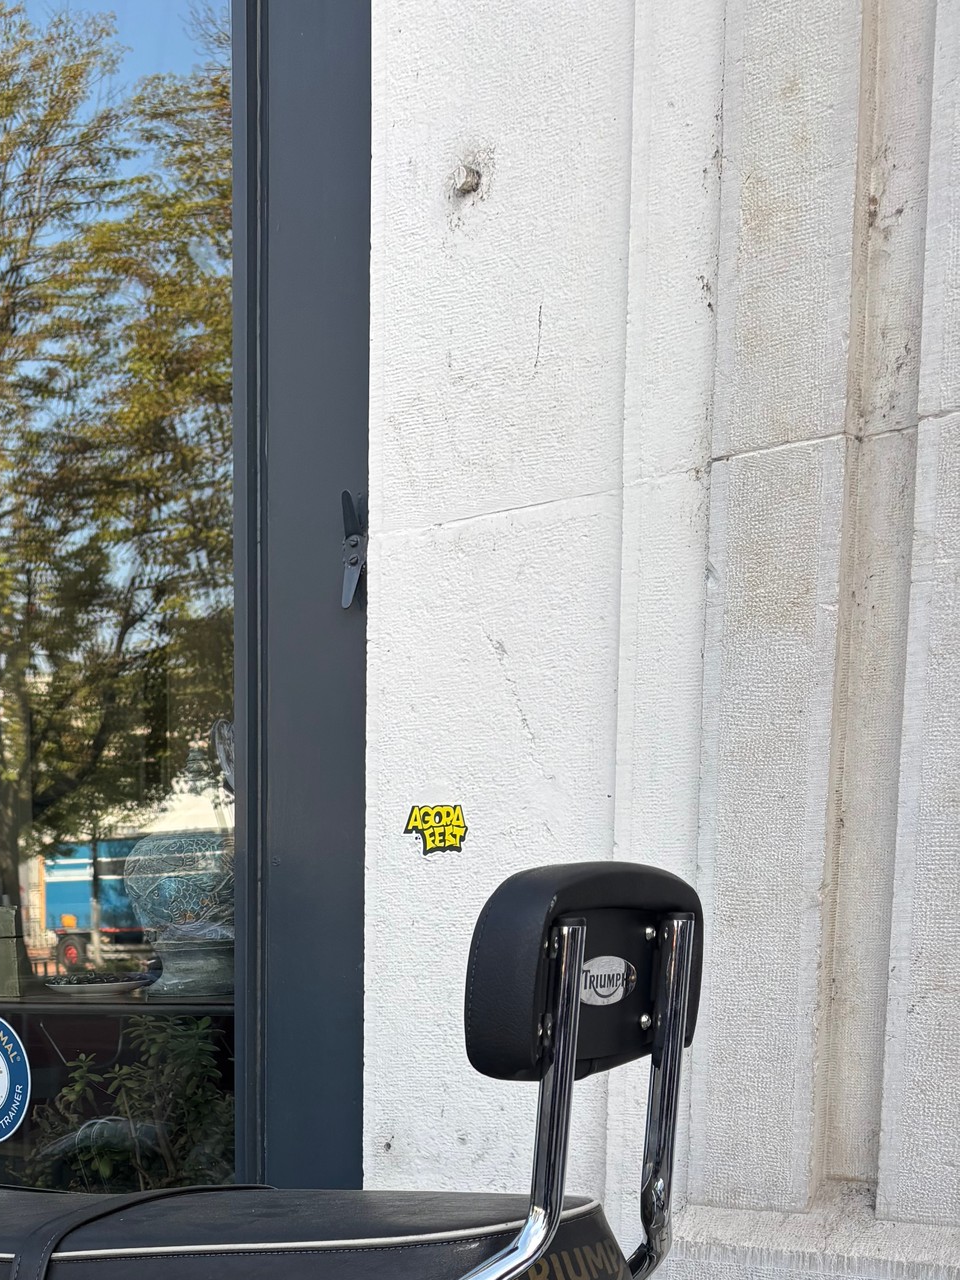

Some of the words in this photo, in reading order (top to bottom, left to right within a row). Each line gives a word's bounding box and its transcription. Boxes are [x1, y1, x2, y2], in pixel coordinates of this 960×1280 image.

[404, 804, 466, 834] AGORA
[423, 825, 468, 853] FEST
[581, 969, 629, 999] TRIUMPH
